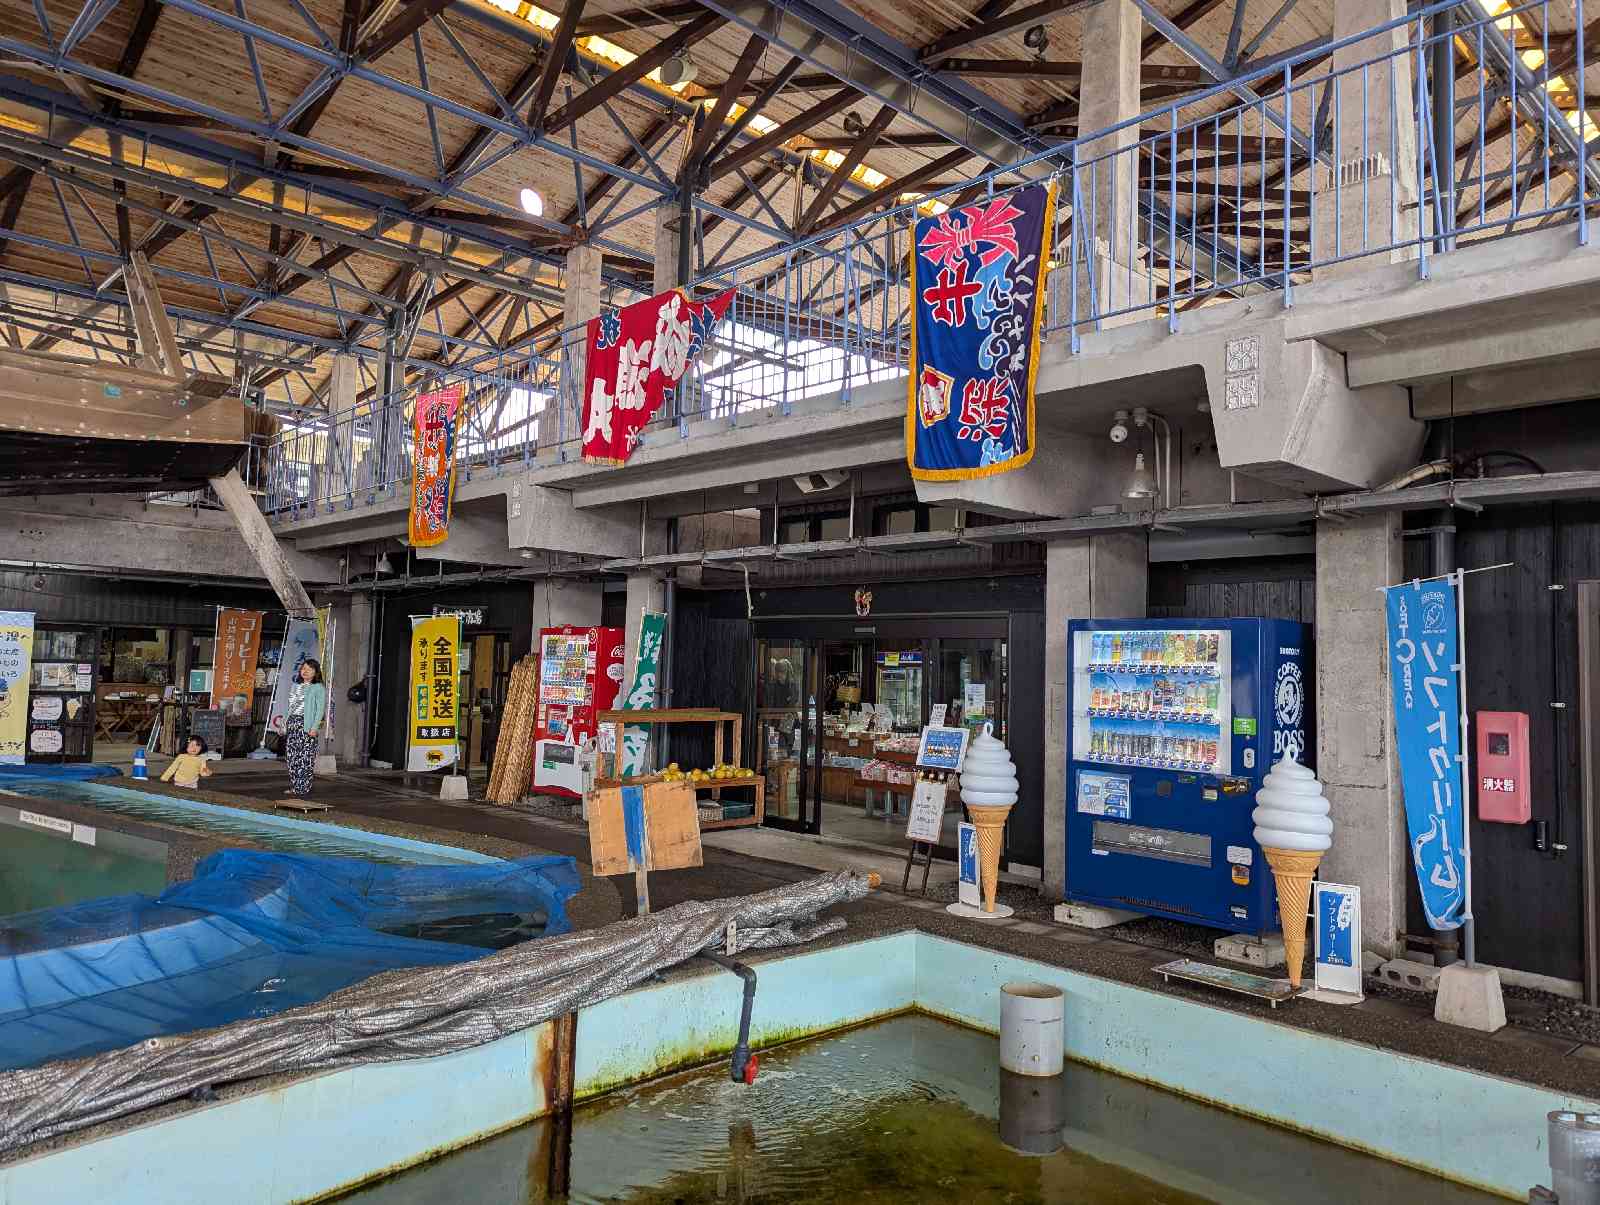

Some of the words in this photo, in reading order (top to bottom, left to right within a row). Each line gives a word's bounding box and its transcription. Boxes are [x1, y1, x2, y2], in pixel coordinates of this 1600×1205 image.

[239, 618, 256, 672] コーヒー
[433, 636, 454, 719] 全国発送
[1277, 661, 1302, 681] COFFEE
[421, 728, 452, 738] 取扱店
[1273, 729, 1305, 754] BOSS
[1483, 777, 1516, 792] 消火器
[1328, 896, 1337, 957] ソフトクリーム
